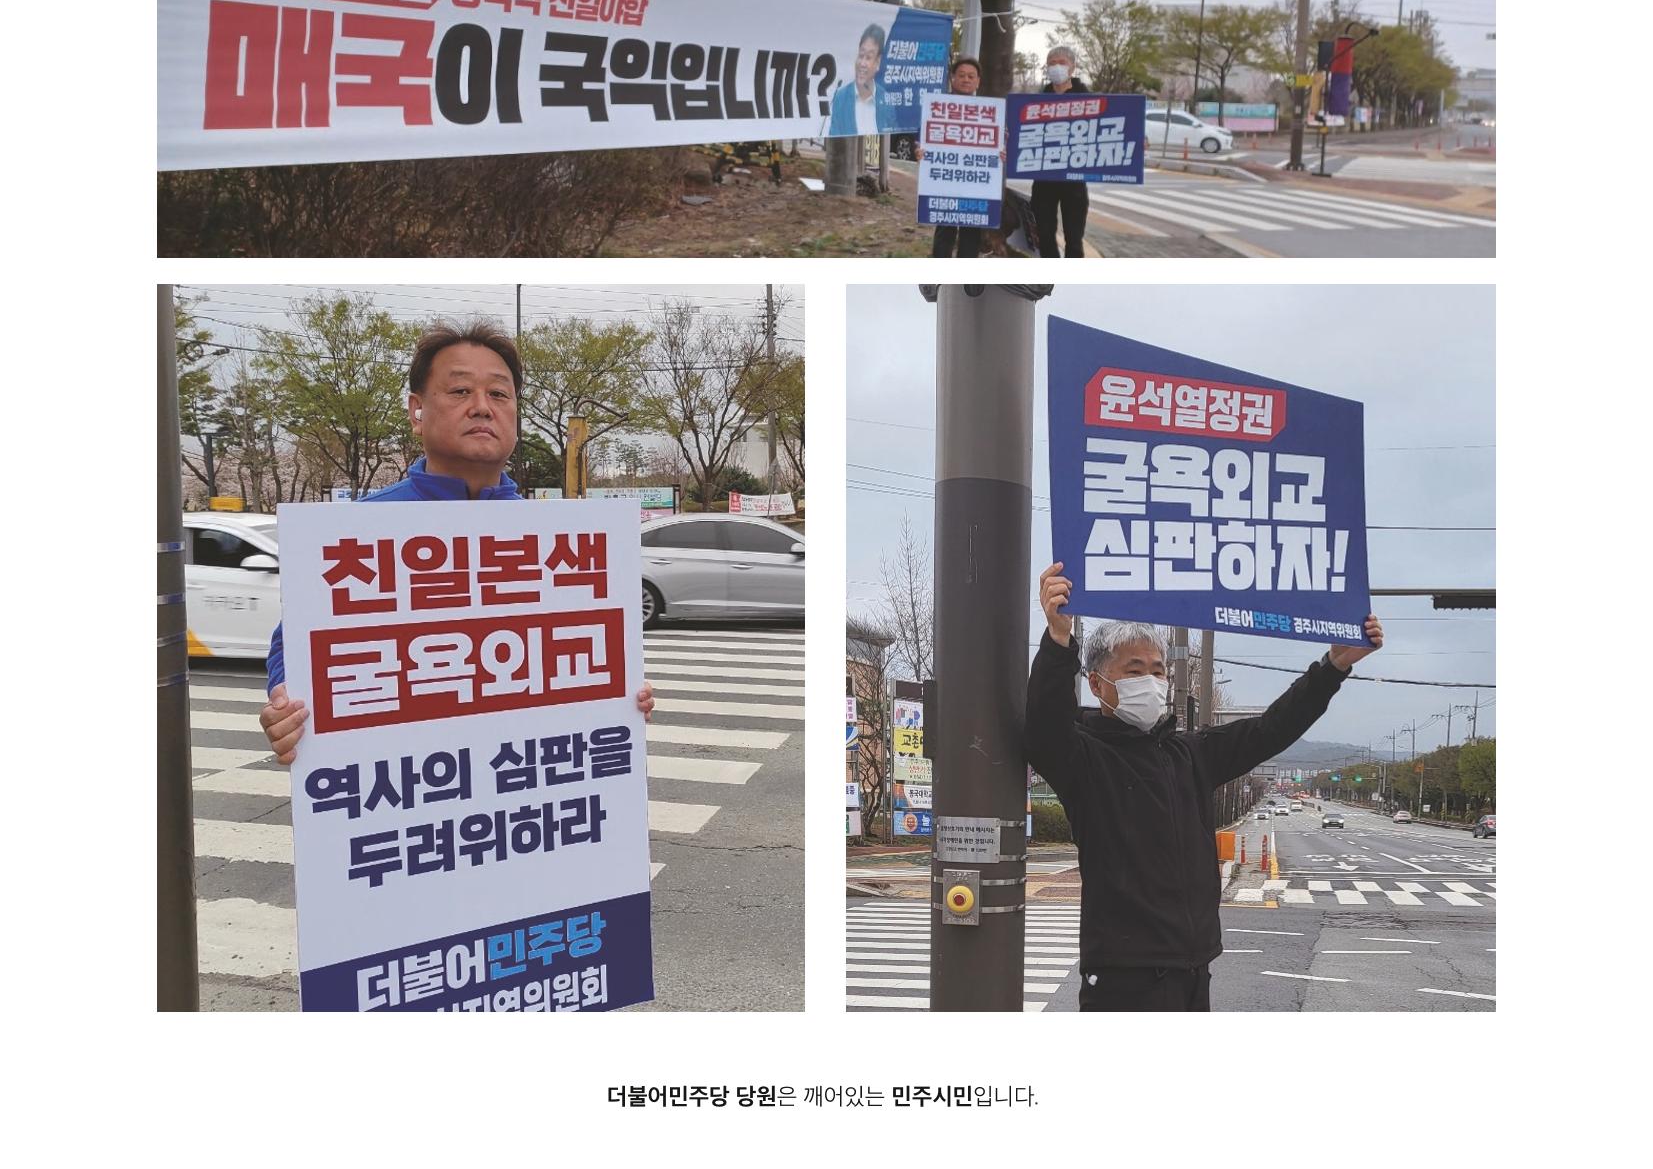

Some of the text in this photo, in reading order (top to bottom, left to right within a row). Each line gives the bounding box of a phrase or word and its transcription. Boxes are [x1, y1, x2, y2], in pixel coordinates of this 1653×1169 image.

[203, 0, 837, 130] 매국이 국익입니까?
[887, 40, 946, 62] 더불어민주당
[930, 101, 997, 123] 친일본색
[1026, 99, 1101, 120] 윤석열정권
[929, 123, 996, 145] 굴욕외교
[1018, 116, 1125, 149] 굴욕외교
[923, 151, 999, 168] 역사의 심판을
[1016, 141, 1136, 172] 심판하자!
[928, 197, 989, 212] 더불어민주당
[1100, 374, 1273, 436] 윤석열정권
[1083, 437, 1326, 523] 굴욕외교
[1084, 518, 1349, 593] 심판하자!
[321, 533, 608, 616] 친일본색
[1215, 606, 1362, 640] 더불어민주당 경주시지역위원회
[327, 623, 611, 718] 굴욕외교
[304, 725, 633, 819] 역사의 심판을
[356, 911, 607, 1012] 더불어민주당
